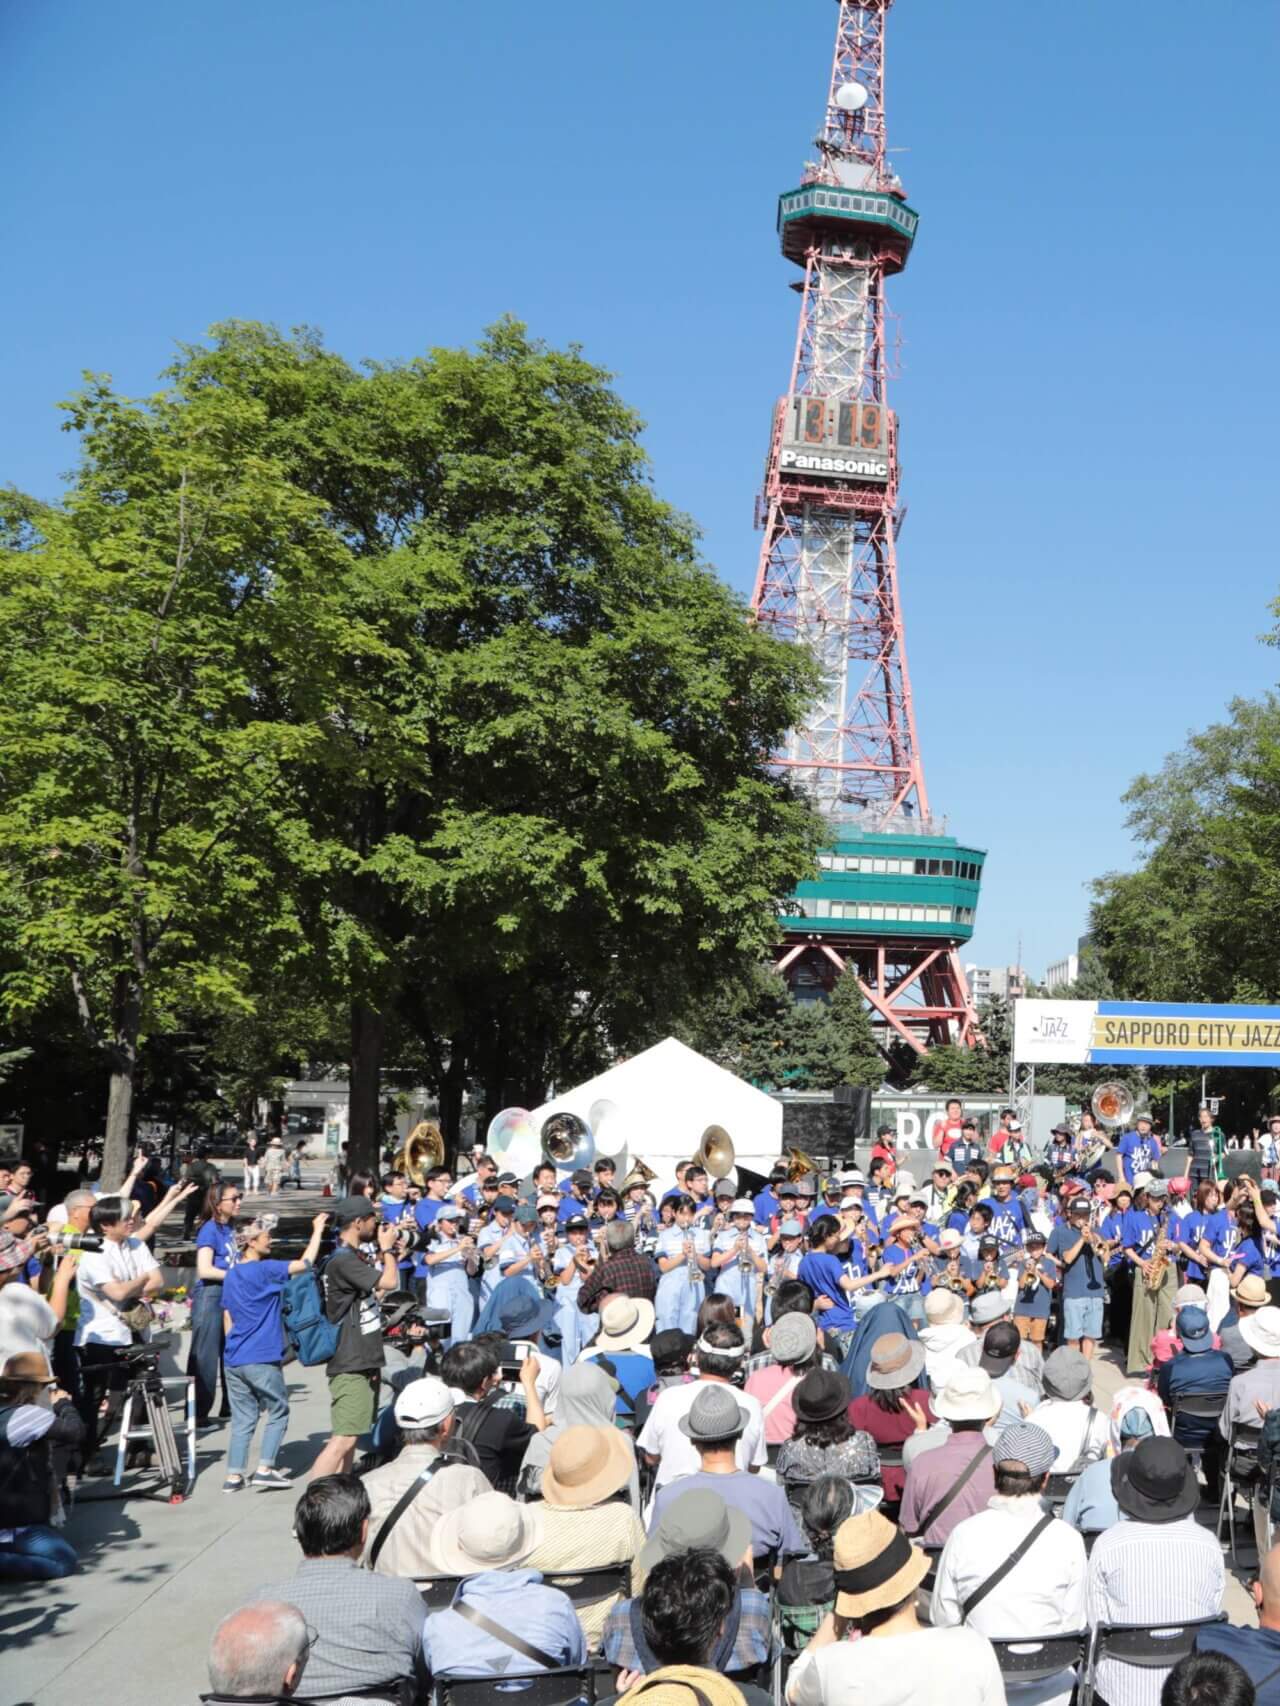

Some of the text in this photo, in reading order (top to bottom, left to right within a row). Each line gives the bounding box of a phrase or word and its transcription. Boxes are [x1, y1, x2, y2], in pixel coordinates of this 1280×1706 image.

[781, 449, 888, 476] Panasonic
[1104, 1020, 1190, 1047] SAPPORO
[1198, 1023, 1236, 1047] CITY
